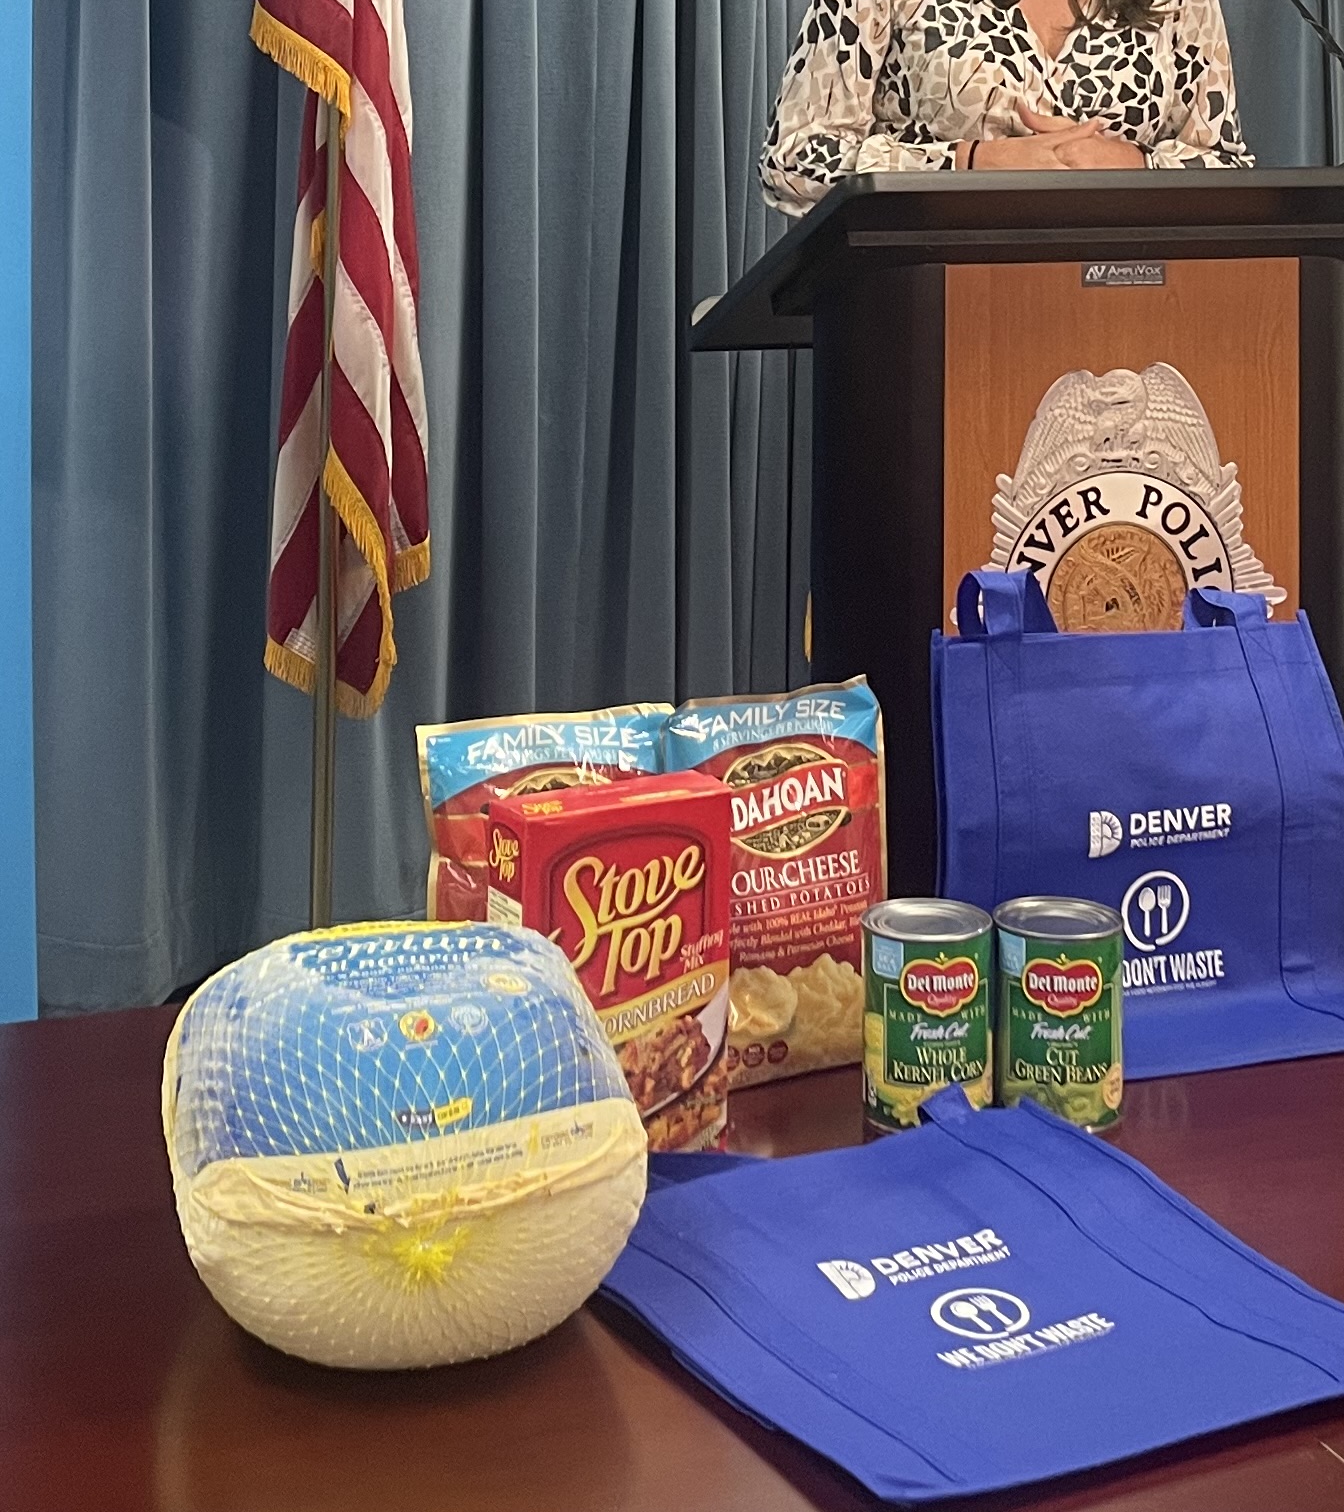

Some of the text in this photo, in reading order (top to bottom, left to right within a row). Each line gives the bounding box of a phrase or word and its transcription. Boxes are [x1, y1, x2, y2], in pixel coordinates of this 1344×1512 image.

[1016, 483, 1224, 590] NVER POLI
[700, 699, 846, 737] FAMILY SIZE
[467, 724, 640, 766] FAMILY SIZE
[731, 767, 844, 832] DAHOAN
[1129, 803, 1233, 836] DENVER
[489, 828, 520, 867] Stove
[496, 856, 516, 883] Top
[731, 850, 860, 897] OUR CHEESE
[560, 845, 705, 969] Stove
[734, 896, 781, 917] SHED
[597, 914, 682, 997] Top
[1169, 949, 1225, 983] WASTE
[906, 972, 974, 993] Del Monte
[1027, 971, 1098, 993] Del Monte
[603, 972, 716, 1035] ORNBREAD
[888, 1010, 923, 1023] MADE
[910, 1022, 945, 1041] Fresh
[892, 1059, 985, 1083] KERNEL CORN
[915, 1046, 968, 1066] WHOLE
[1015, 1058, 1108, 1084] GREEN BEANS
[1045, 1046, 1080, 1066] CUT
[870, 1228, 1004, 1275] DENVER
[889, 1246, 1011, 1287] POLICE DEPARTMENT
[936, 1347, 983, 1369] WE
[1034, 1312, 1115, 1346] WASTE
